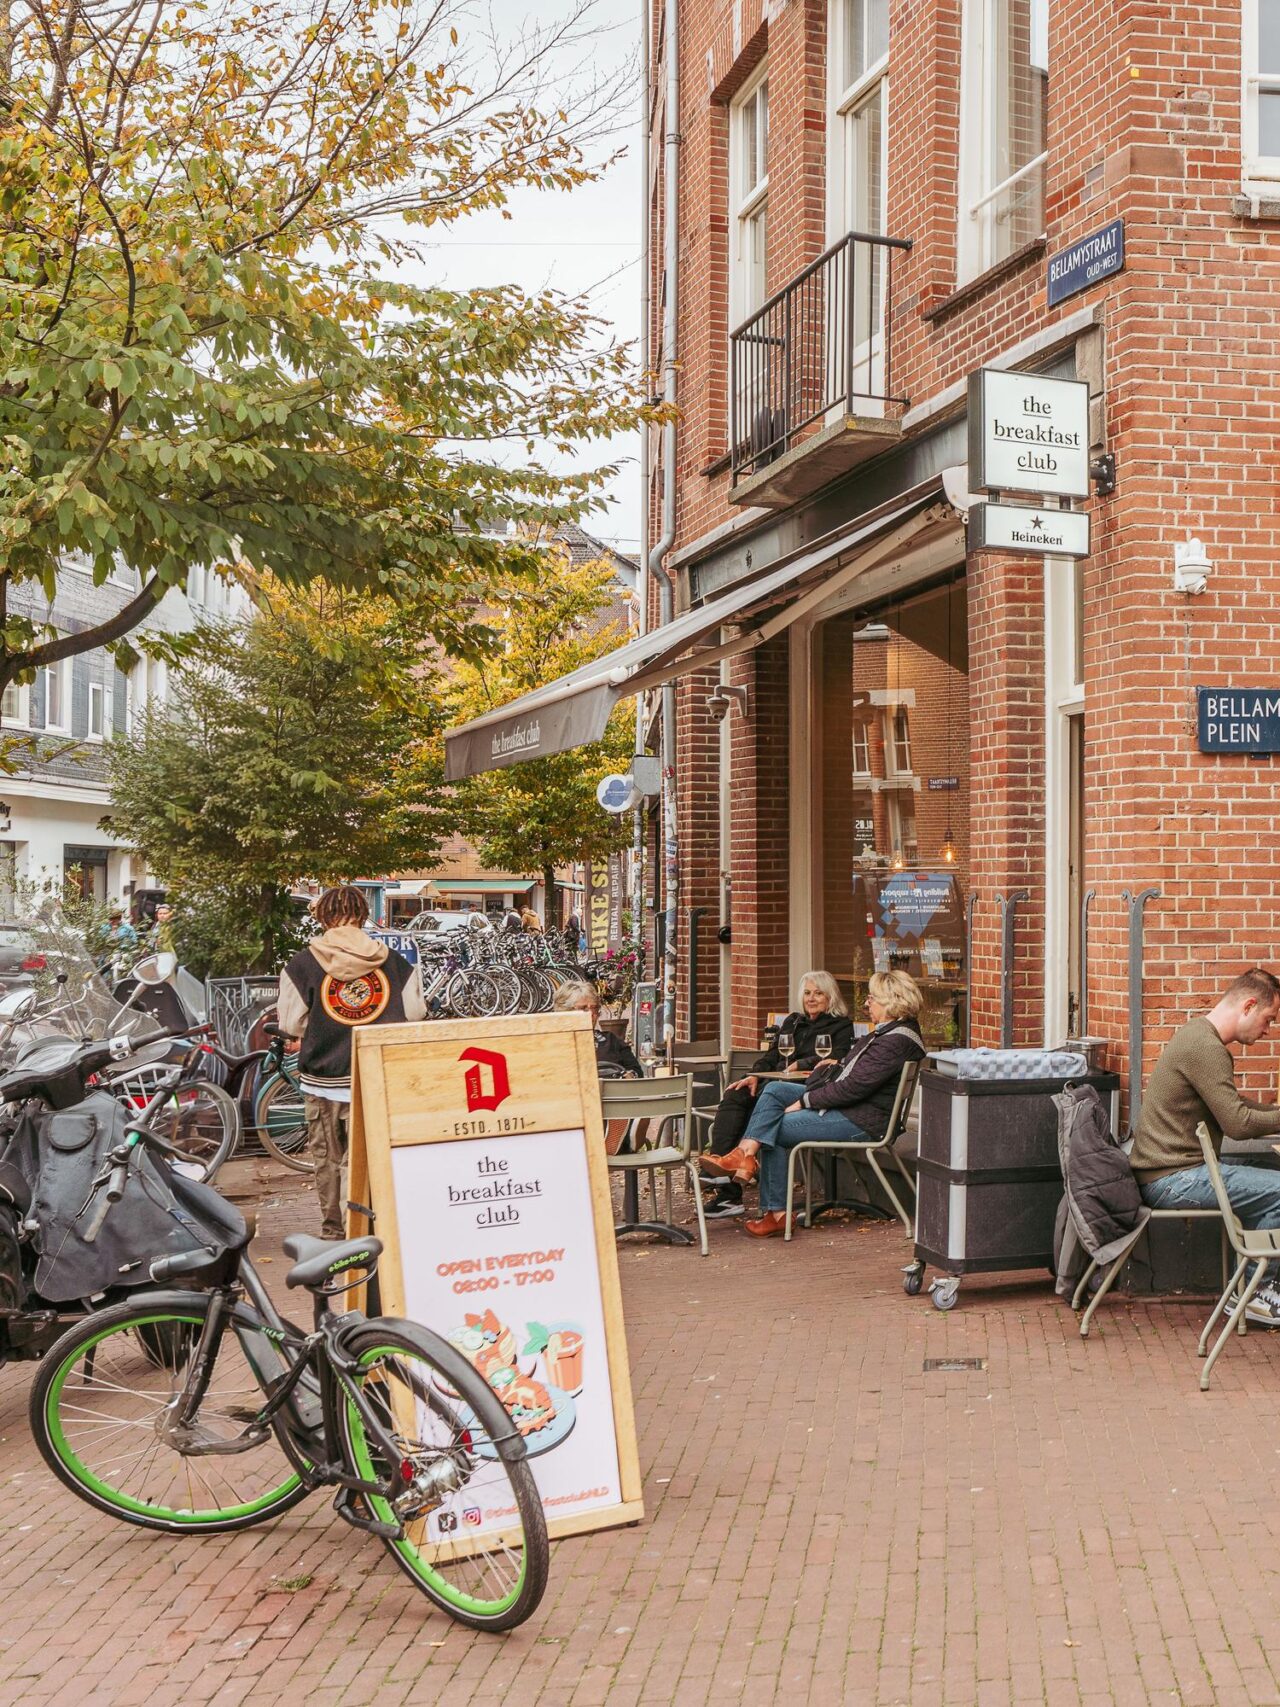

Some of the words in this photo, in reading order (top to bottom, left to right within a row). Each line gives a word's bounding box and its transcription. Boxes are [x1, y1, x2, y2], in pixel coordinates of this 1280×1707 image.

[1050, 227, 1117, 282] BELLAMYSTRAAT
[1086, 252, 1118, 279] OUD-WEST
[1022, 395, 1052, 415] the
[993, 419, 1080, 446] breakfast
[1017, 451, 1058, 471] club
[1011, 530, 1063, 546] Heineken
[491, 733, 501, 755] the
[501, 725, 526, 752] breakfast
[526, 719, 541, 744] club
[1207, 723, 1260, 743] PLEIN
[611, 864, 620, 898] REPAIR
[591, 894, 610, 955] BIKE
[610, 905, 619, 941] RENTAL
[454, 1120, 491, 1136] ESTD.
[497, 1117, 525, 1132] 1871
[477, 1156, 509, 1173] the
[448, 1179, 542, 1202] breakfast
[476, 1205, 520, 1225] club
[328, 1251, 370, 1273] e-bike-to-go
[436, 1259, 482, 1277] OPEN
[485, 1248, 565, 1271] EVERYDAY
[452, 1276, 499, 1294] 08:00
[513, 1269, 555, 1286] 17:00
